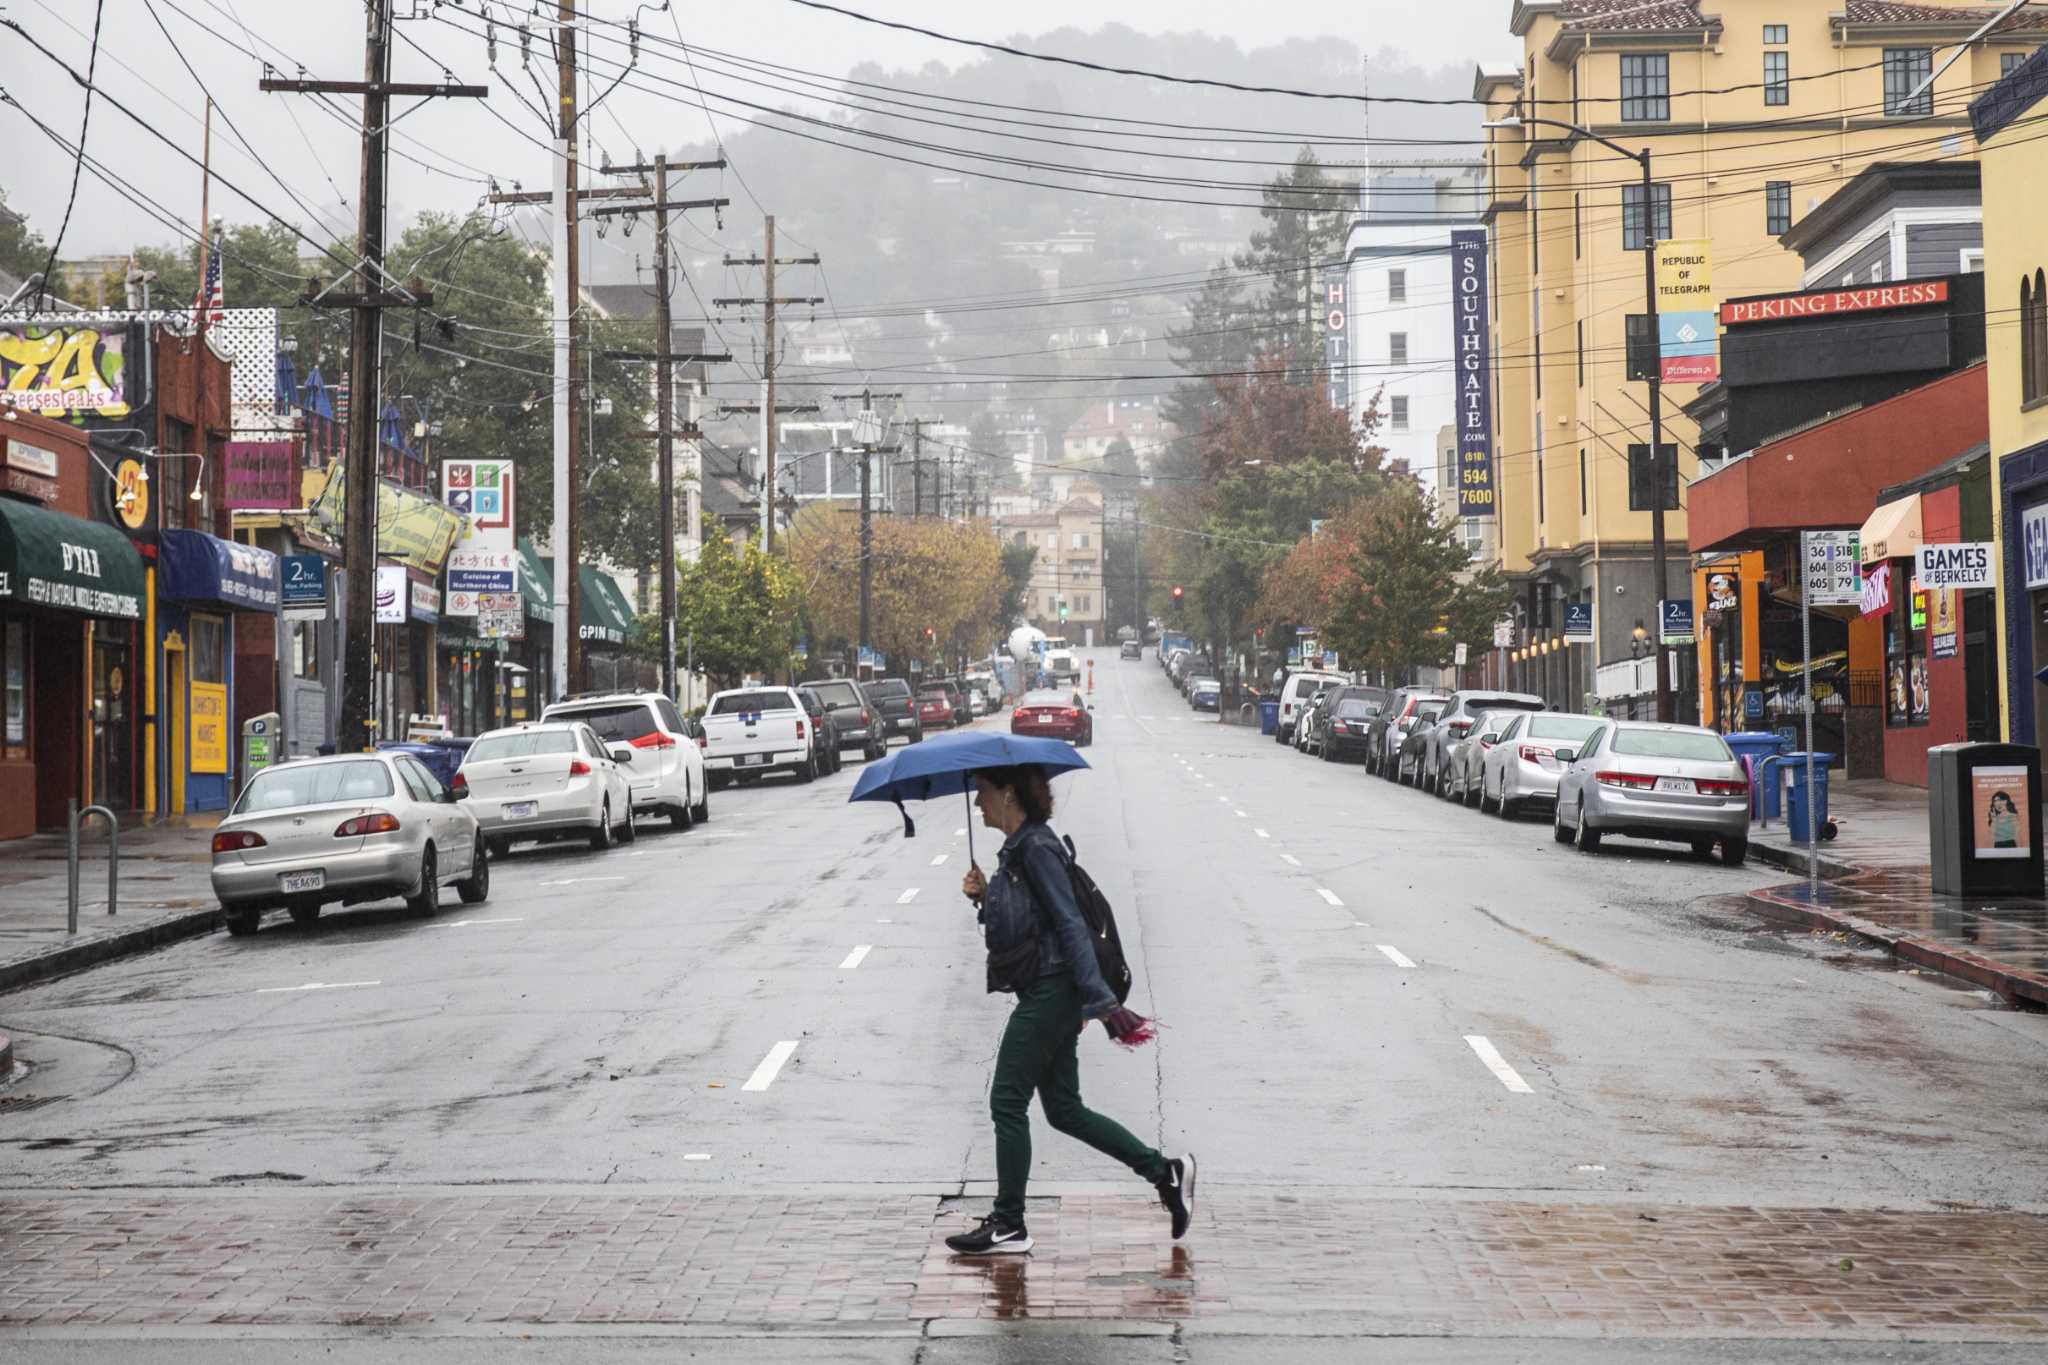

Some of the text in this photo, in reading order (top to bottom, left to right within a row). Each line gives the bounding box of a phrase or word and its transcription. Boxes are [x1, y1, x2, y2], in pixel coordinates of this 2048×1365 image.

[1662, 255, 1706, 266] REPUBLIC
[1679, 270, 1690, 279] OF
[1660, 285, 1711, 295] TELEGRAPH
[1732, 283, 1938, 321] PEKING EXPRESS
[1328, 283, 1345, 409] HOTEL
[1462, 256, 1481, 429] SOUTHGATE
[1463, 469, 1488, 484] 594
[1460, 489, 1493, 505] 7600
[1811, 545, 1853, 557] 36 51B
[1873, 540, 1888, 559] PIZZA
[60, 542, 101, 578] D'YAR
[1923, 548, 1987, 570] GAMES
[290, 561, 304, 581] 2
[303, 571, 317, 581] hr.
[1809, 562, 1852, 573] 604 851
[462, 572, 491, 580] Cuisine
[1934, 568, 1987, 583] BERKELEY
[1810, 577, 1852, 589] 605 79
[1571, 606, 1579, 618] 2
[1669, 603, 1679, 617] 2
[255, 722, 264, 733] P
